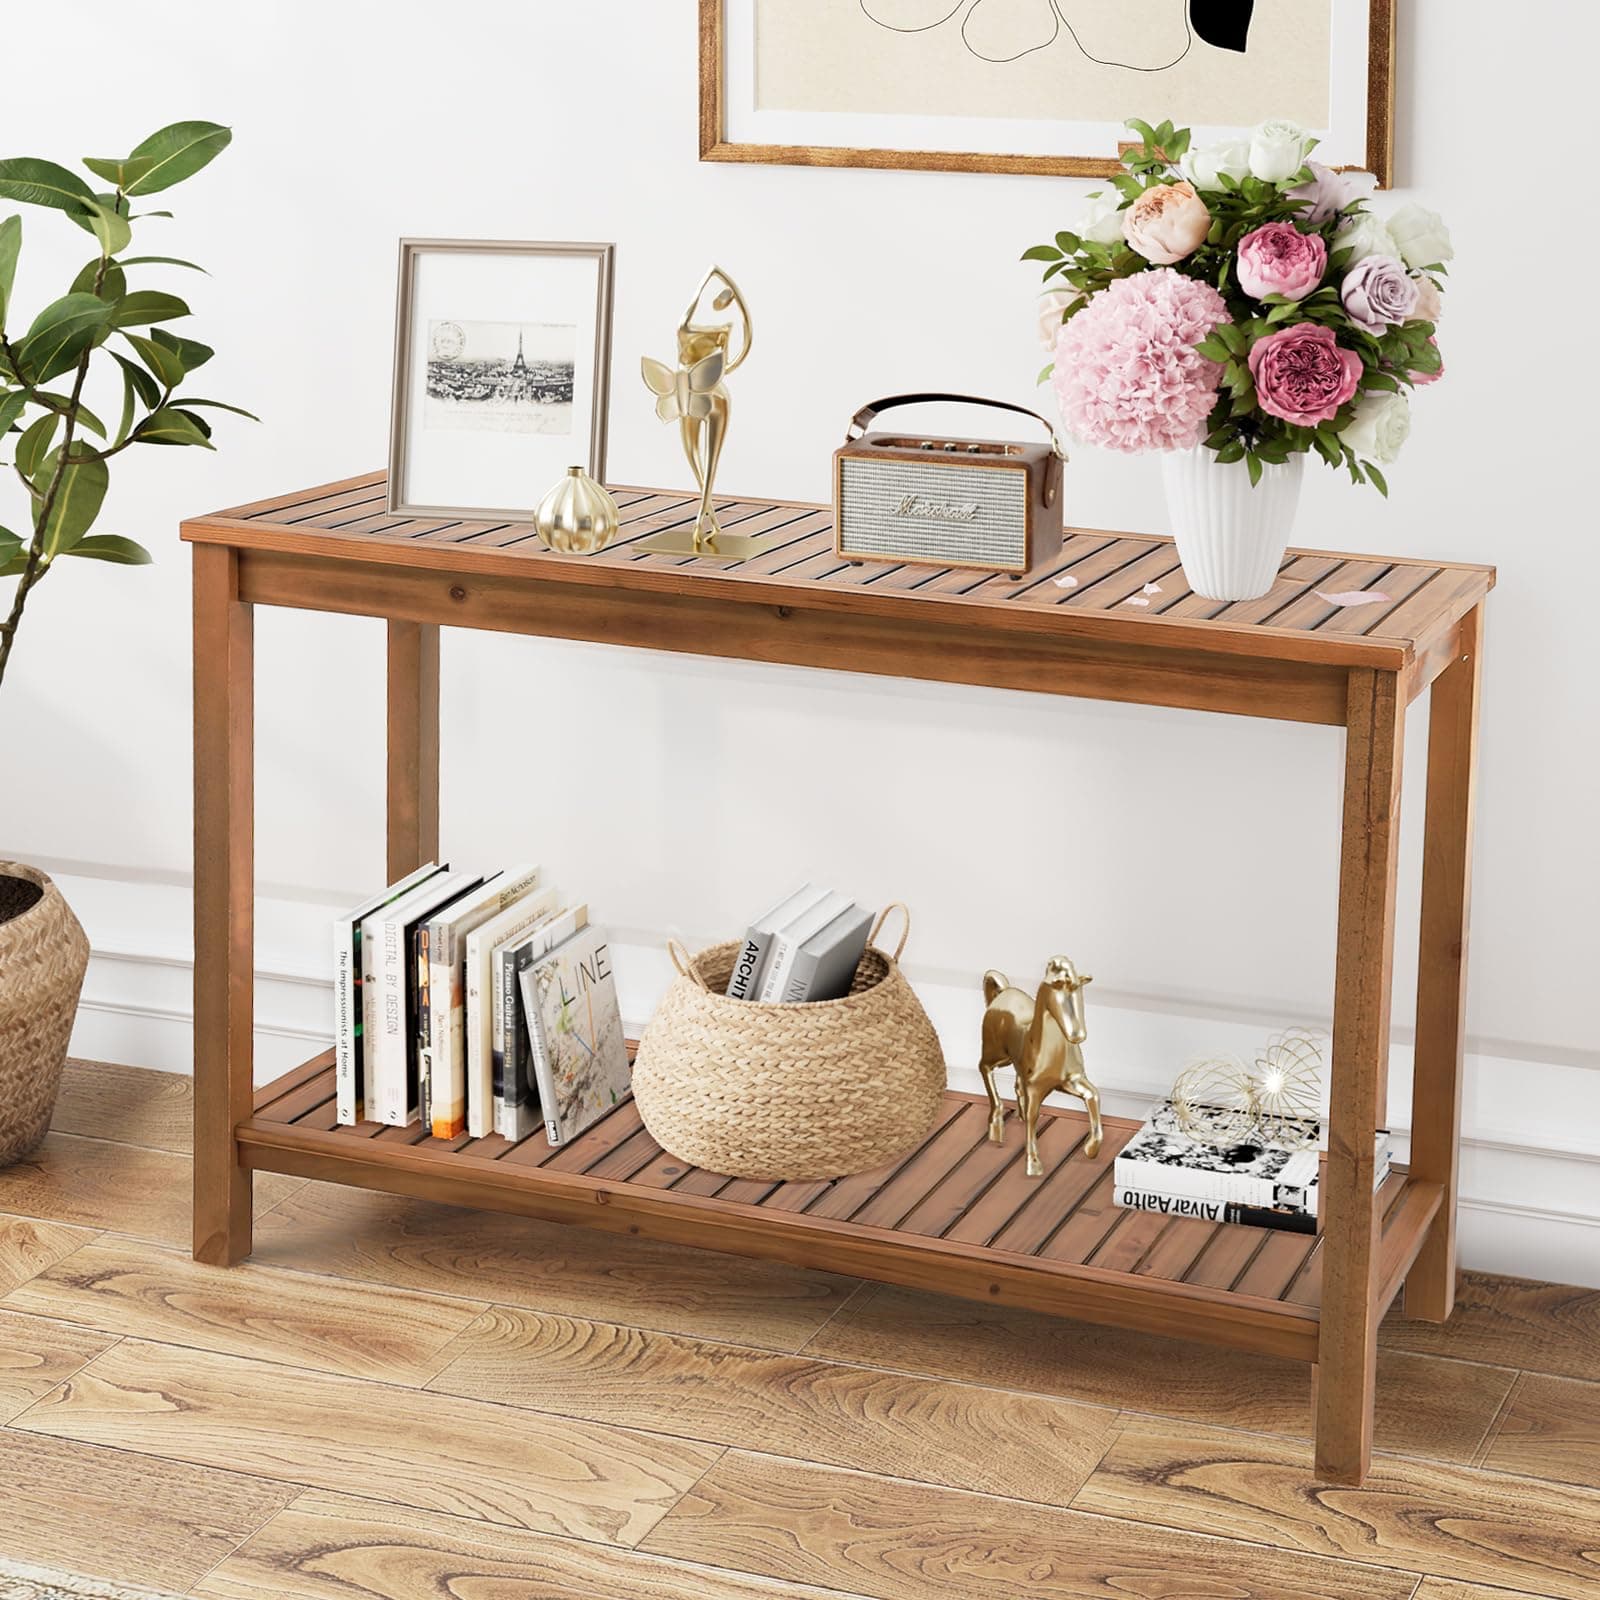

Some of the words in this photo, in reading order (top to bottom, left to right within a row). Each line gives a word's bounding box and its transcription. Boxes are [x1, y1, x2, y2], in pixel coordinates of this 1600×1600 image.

[890, 494, 978, 520] Marshall
[339, 950, 348, 967] The
[385, 922, 397, 967] DIGITAL
[386, 974, 398, 987] BY
[504, 962, 514, 994] Picasso
[340, 969, 348, 1037] Impressionists
[386, 993, 399, 1036] DESIGN
[341, 1039, 349, 1049] at
[341, 1051, 349, 1079] Home
